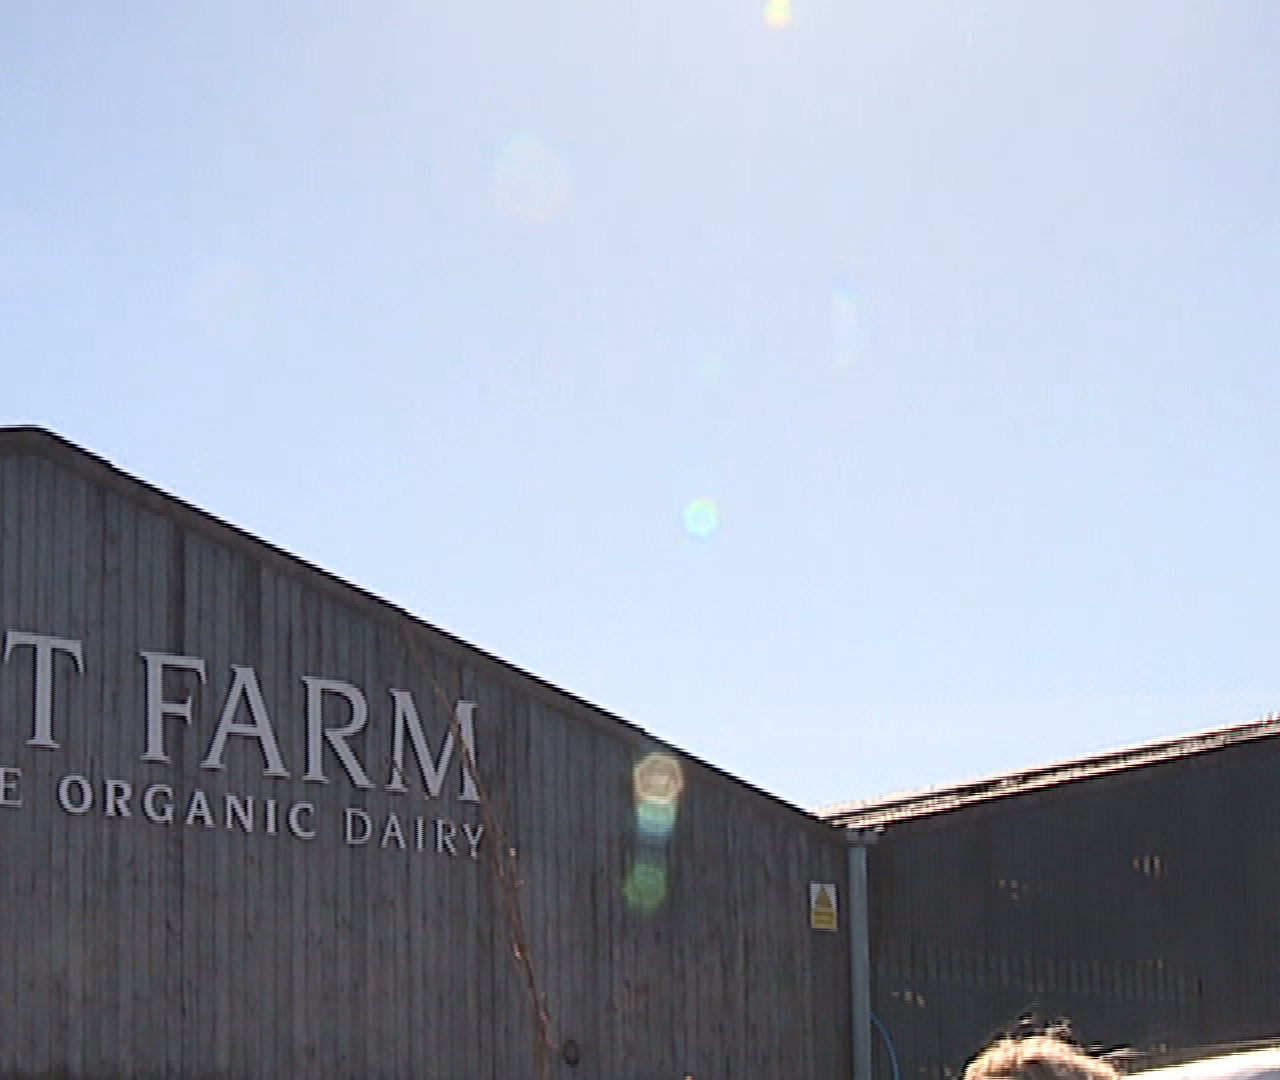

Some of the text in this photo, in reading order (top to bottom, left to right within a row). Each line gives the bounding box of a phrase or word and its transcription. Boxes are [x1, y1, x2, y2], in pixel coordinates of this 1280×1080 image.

[139, 651, 480, 802] FARM
[56, 774, 317, 838] ORGANIC
[345, 808, 484, 858] DAIRY
